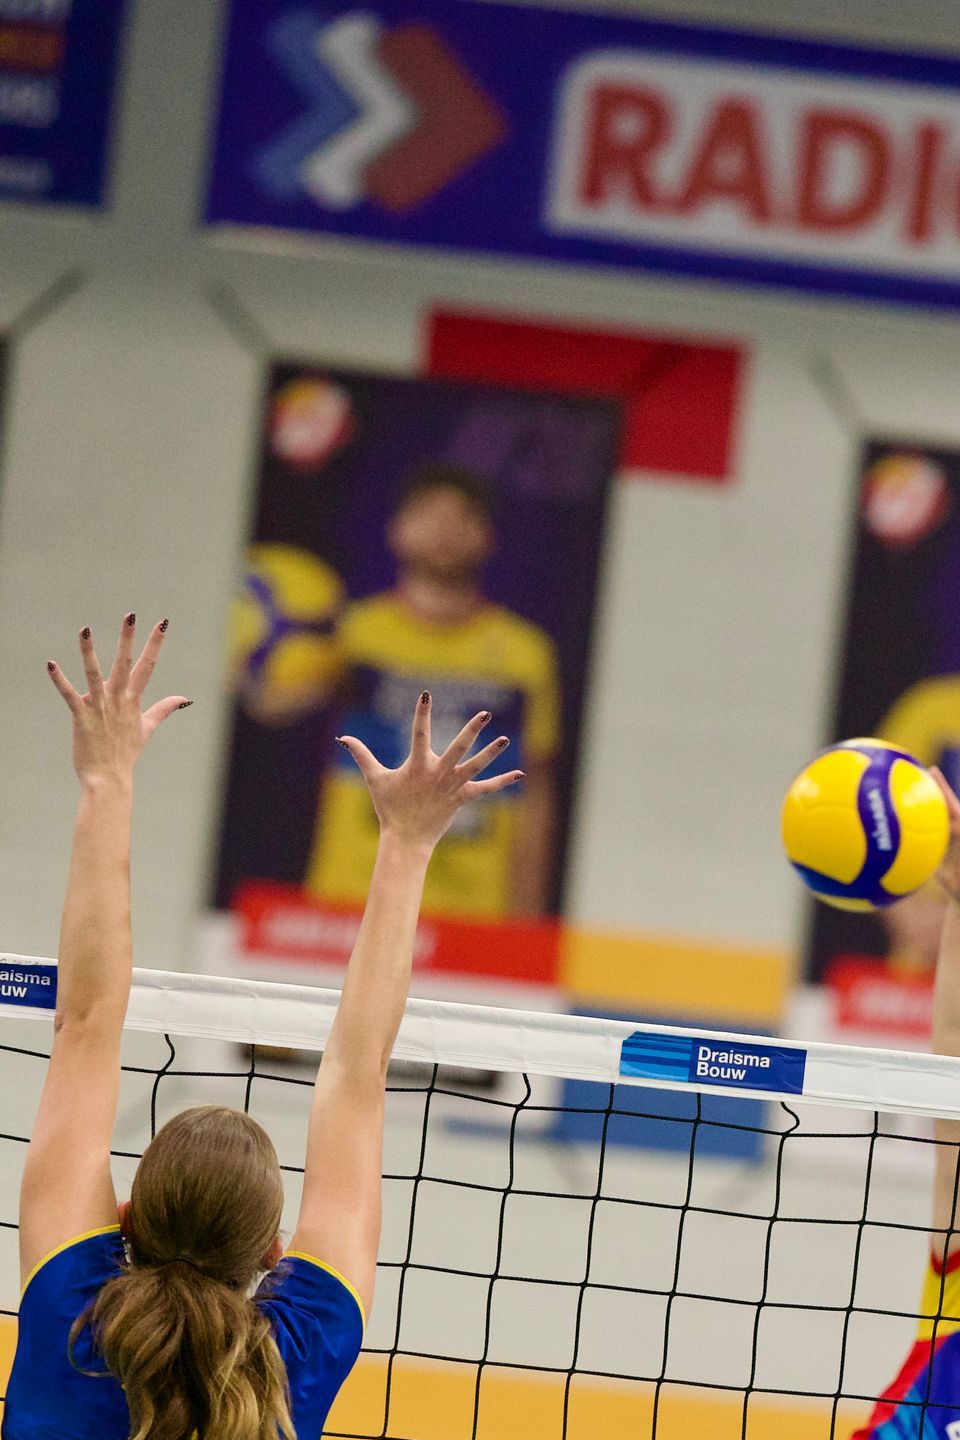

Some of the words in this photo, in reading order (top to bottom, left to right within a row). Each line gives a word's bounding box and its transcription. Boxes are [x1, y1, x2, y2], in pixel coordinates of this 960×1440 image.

[0, 969, 51, 986] aisma
[0, 984, 28, 998] uw
[698, 1046, 770, 1068] Draisma
[696, 1061, 747, 1080] Bouw
